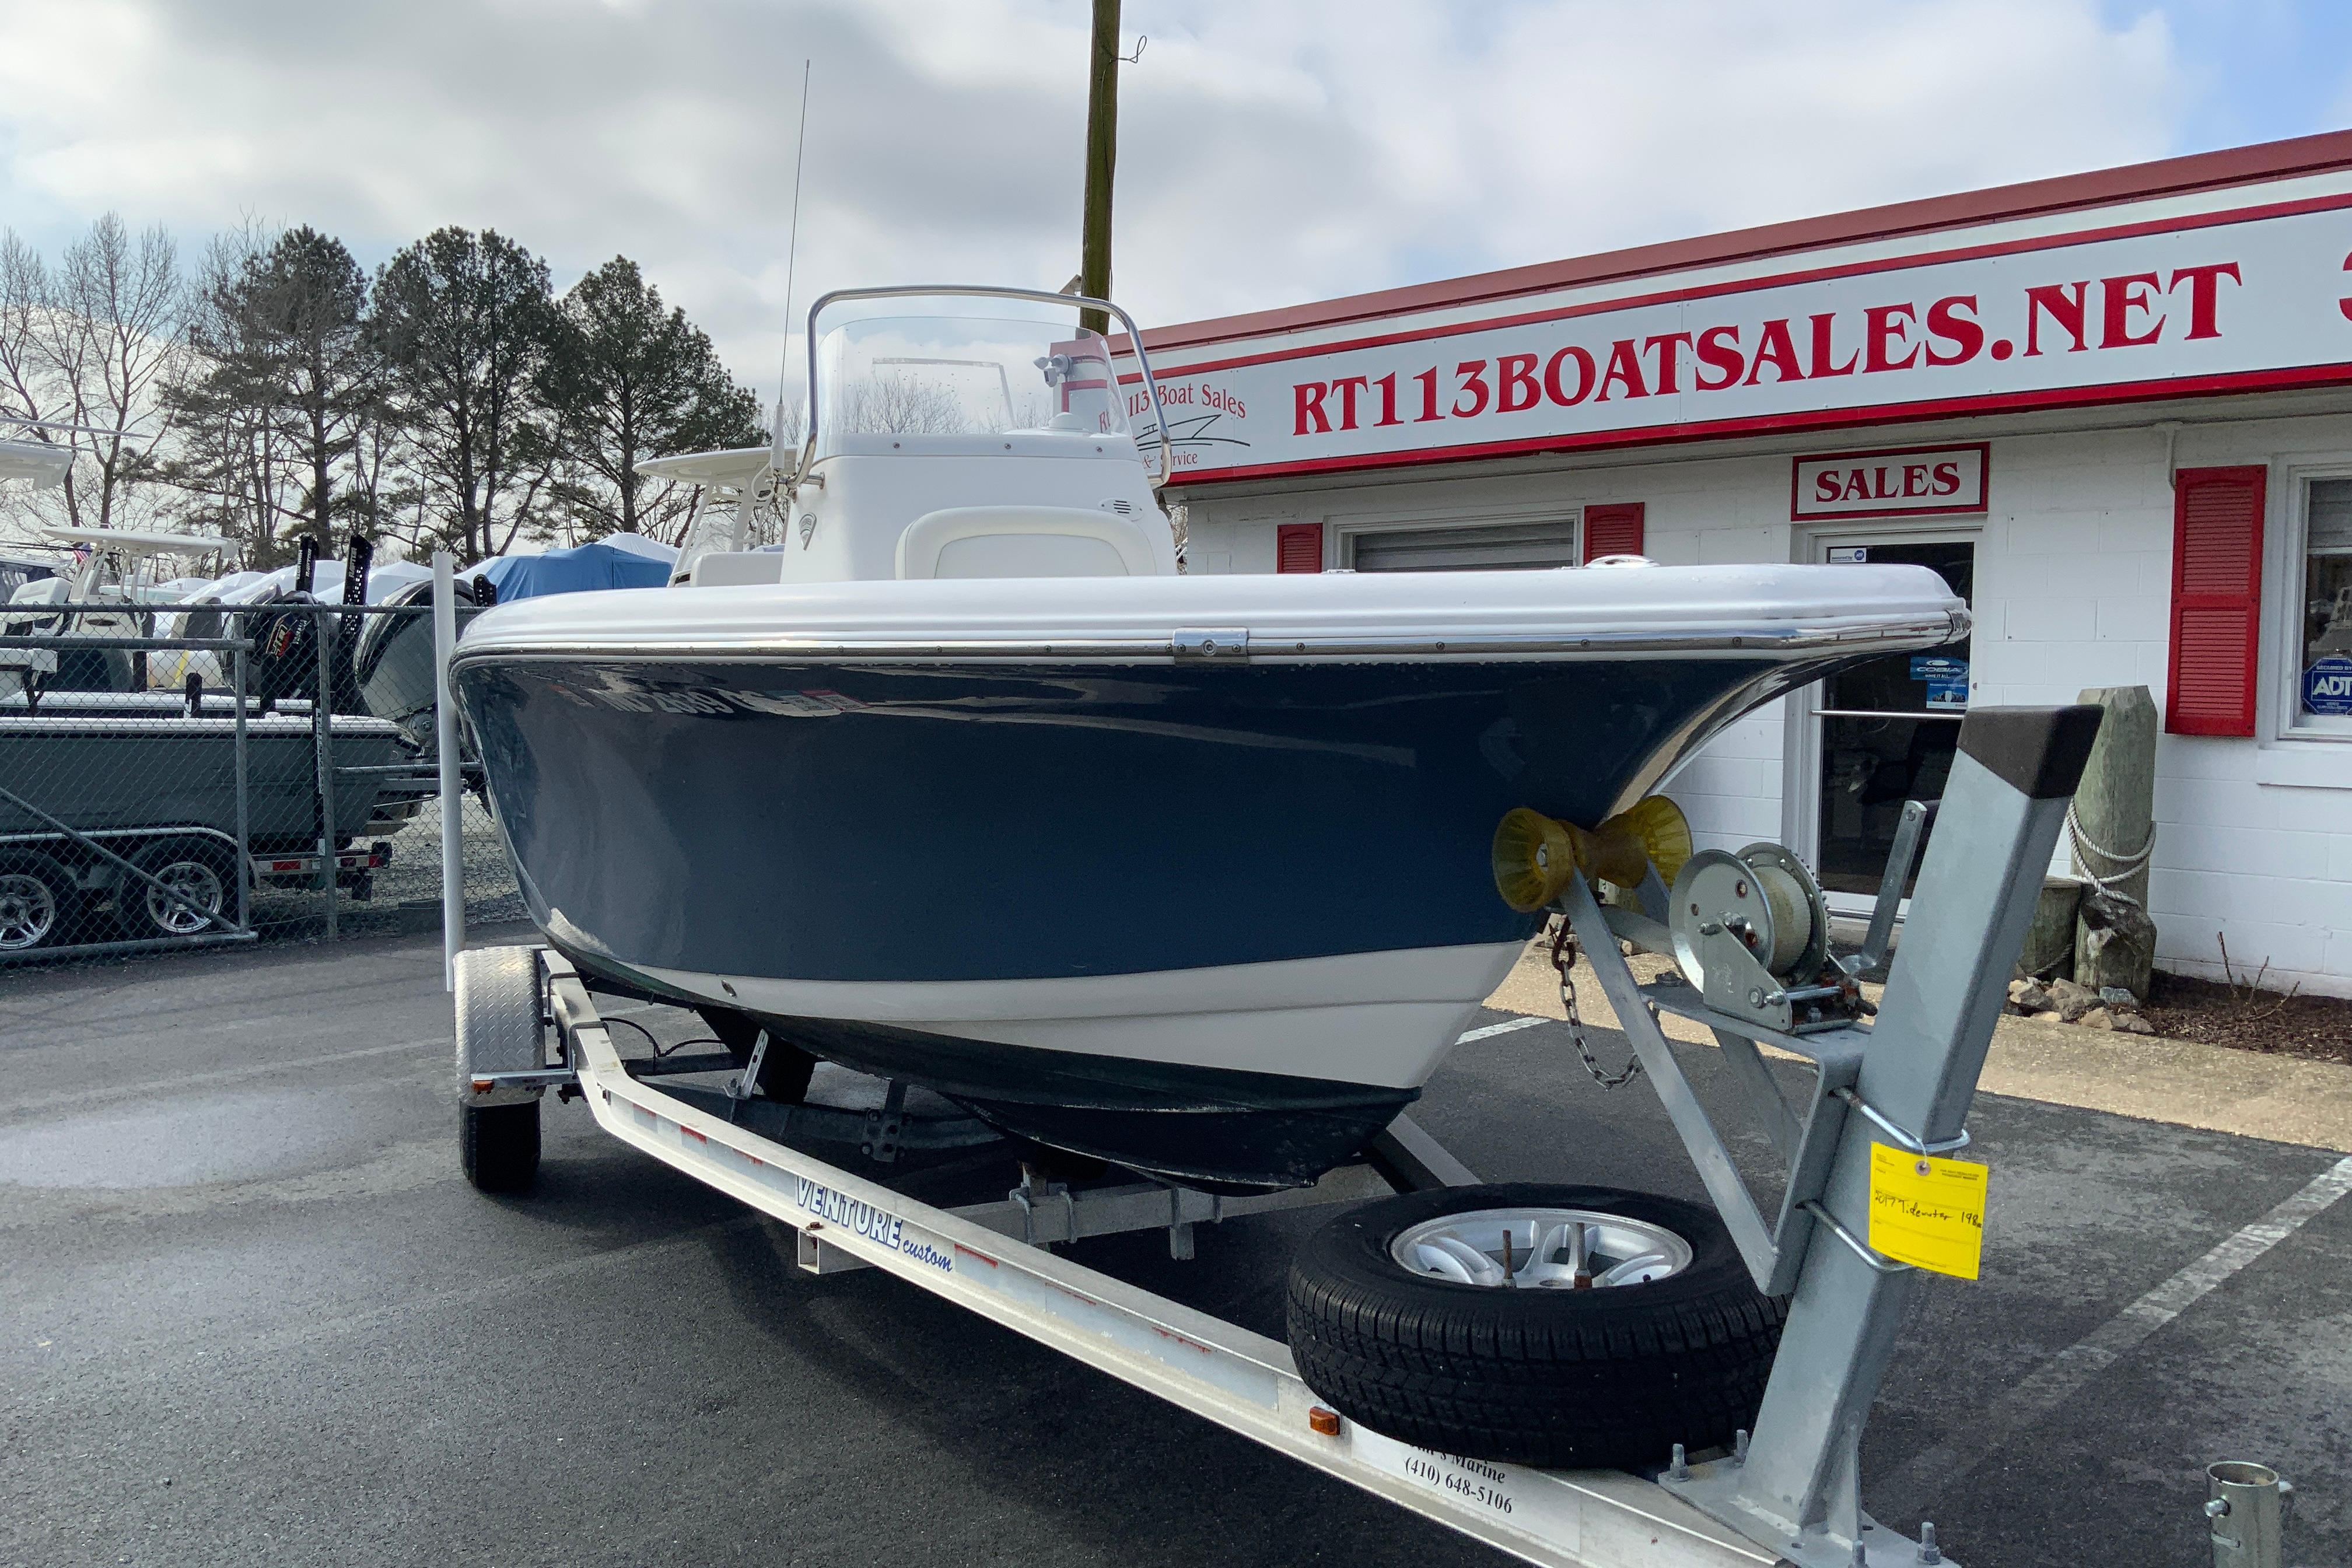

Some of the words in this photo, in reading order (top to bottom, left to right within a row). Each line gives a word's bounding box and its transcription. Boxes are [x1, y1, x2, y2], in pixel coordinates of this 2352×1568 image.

[1293, 262, 2241, 436] RT113BOATSALES.NET
[1128, 389, 1151, 418] 113
[1157, 383, 1195, 407] Boat
[1201, 384, 1246, 419] Sales
[1815, 461, 1961, 503] SALES
[2312, 676, 2352, 696] ADT
[797, 1175, 904, 1250] VENTURE
[902, 1240, 953, 1273] custom
[1405, 1457, 1440, 1486] (410)
[1445, 1473, 1512, 1514] 648-5106
[1452, 1454, 1506, 1483] Marine
